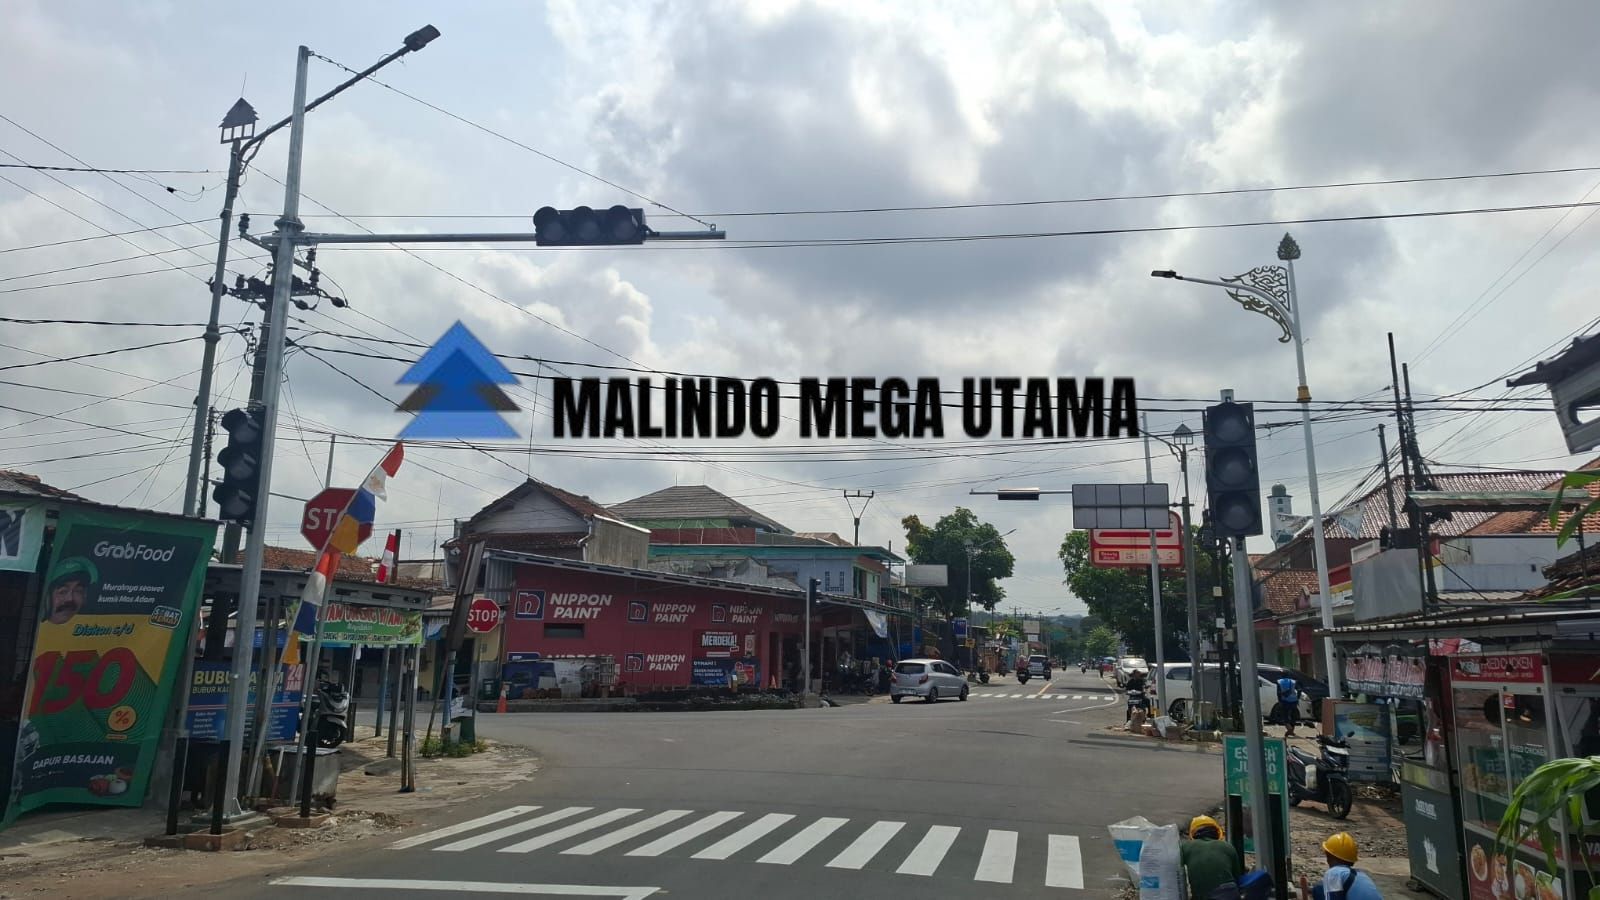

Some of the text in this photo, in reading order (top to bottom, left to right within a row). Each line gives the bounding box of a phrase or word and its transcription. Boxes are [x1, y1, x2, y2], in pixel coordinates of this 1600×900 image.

[94, 541, 175, 562] GrabFood
[550, 593, 613, 606] NIPPON
[553, 607, 602, 619] PAINT
[652, 603, 696, 614] NIPPON
[467, 610, 497, 622] STOP
[655, 614, 688, 623] PAINT
[732, 615, 757, 624] PAINT
[702, 634, 737, 646] MERDEKA!
[647, 654, 685, 663] NIPPON
[286, 664, 303, 681] 24
[649, 663, 680, 672] PAINT
[28, 647, 137, 717] 150
[285, 681, 301, 691] JAM
[32, 754, 115, 770] DAPUR BASAJAN
